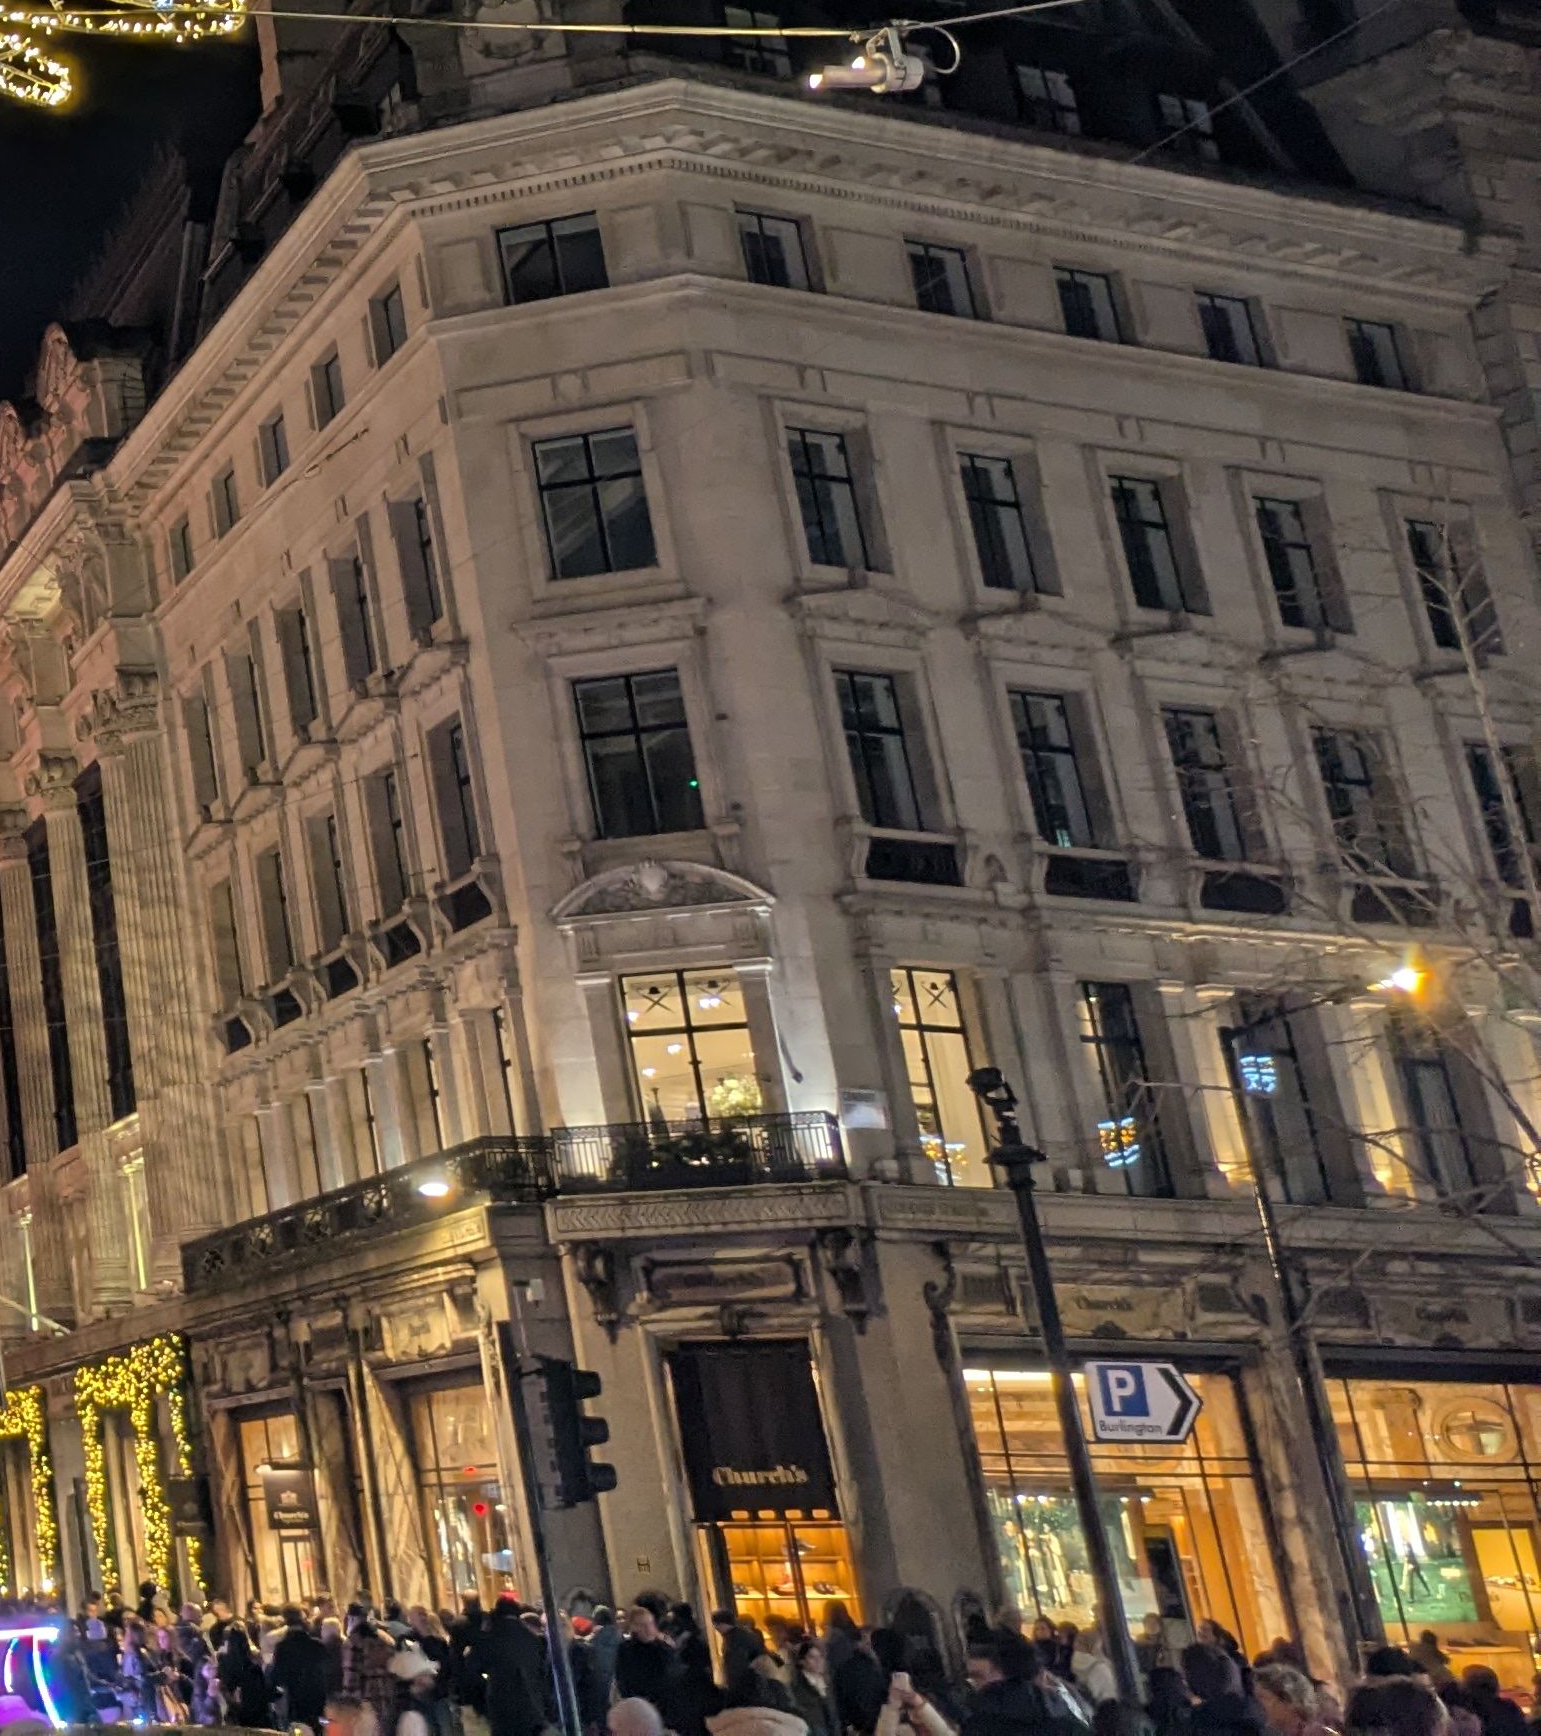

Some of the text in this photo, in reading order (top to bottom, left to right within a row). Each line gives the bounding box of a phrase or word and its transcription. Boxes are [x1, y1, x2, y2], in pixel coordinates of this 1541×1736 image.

[1106, 1369, 1135, 1413] P
[1099, 1419, 1163, 1437] Burlington
[712, 1464, 809, 1486] Church's
